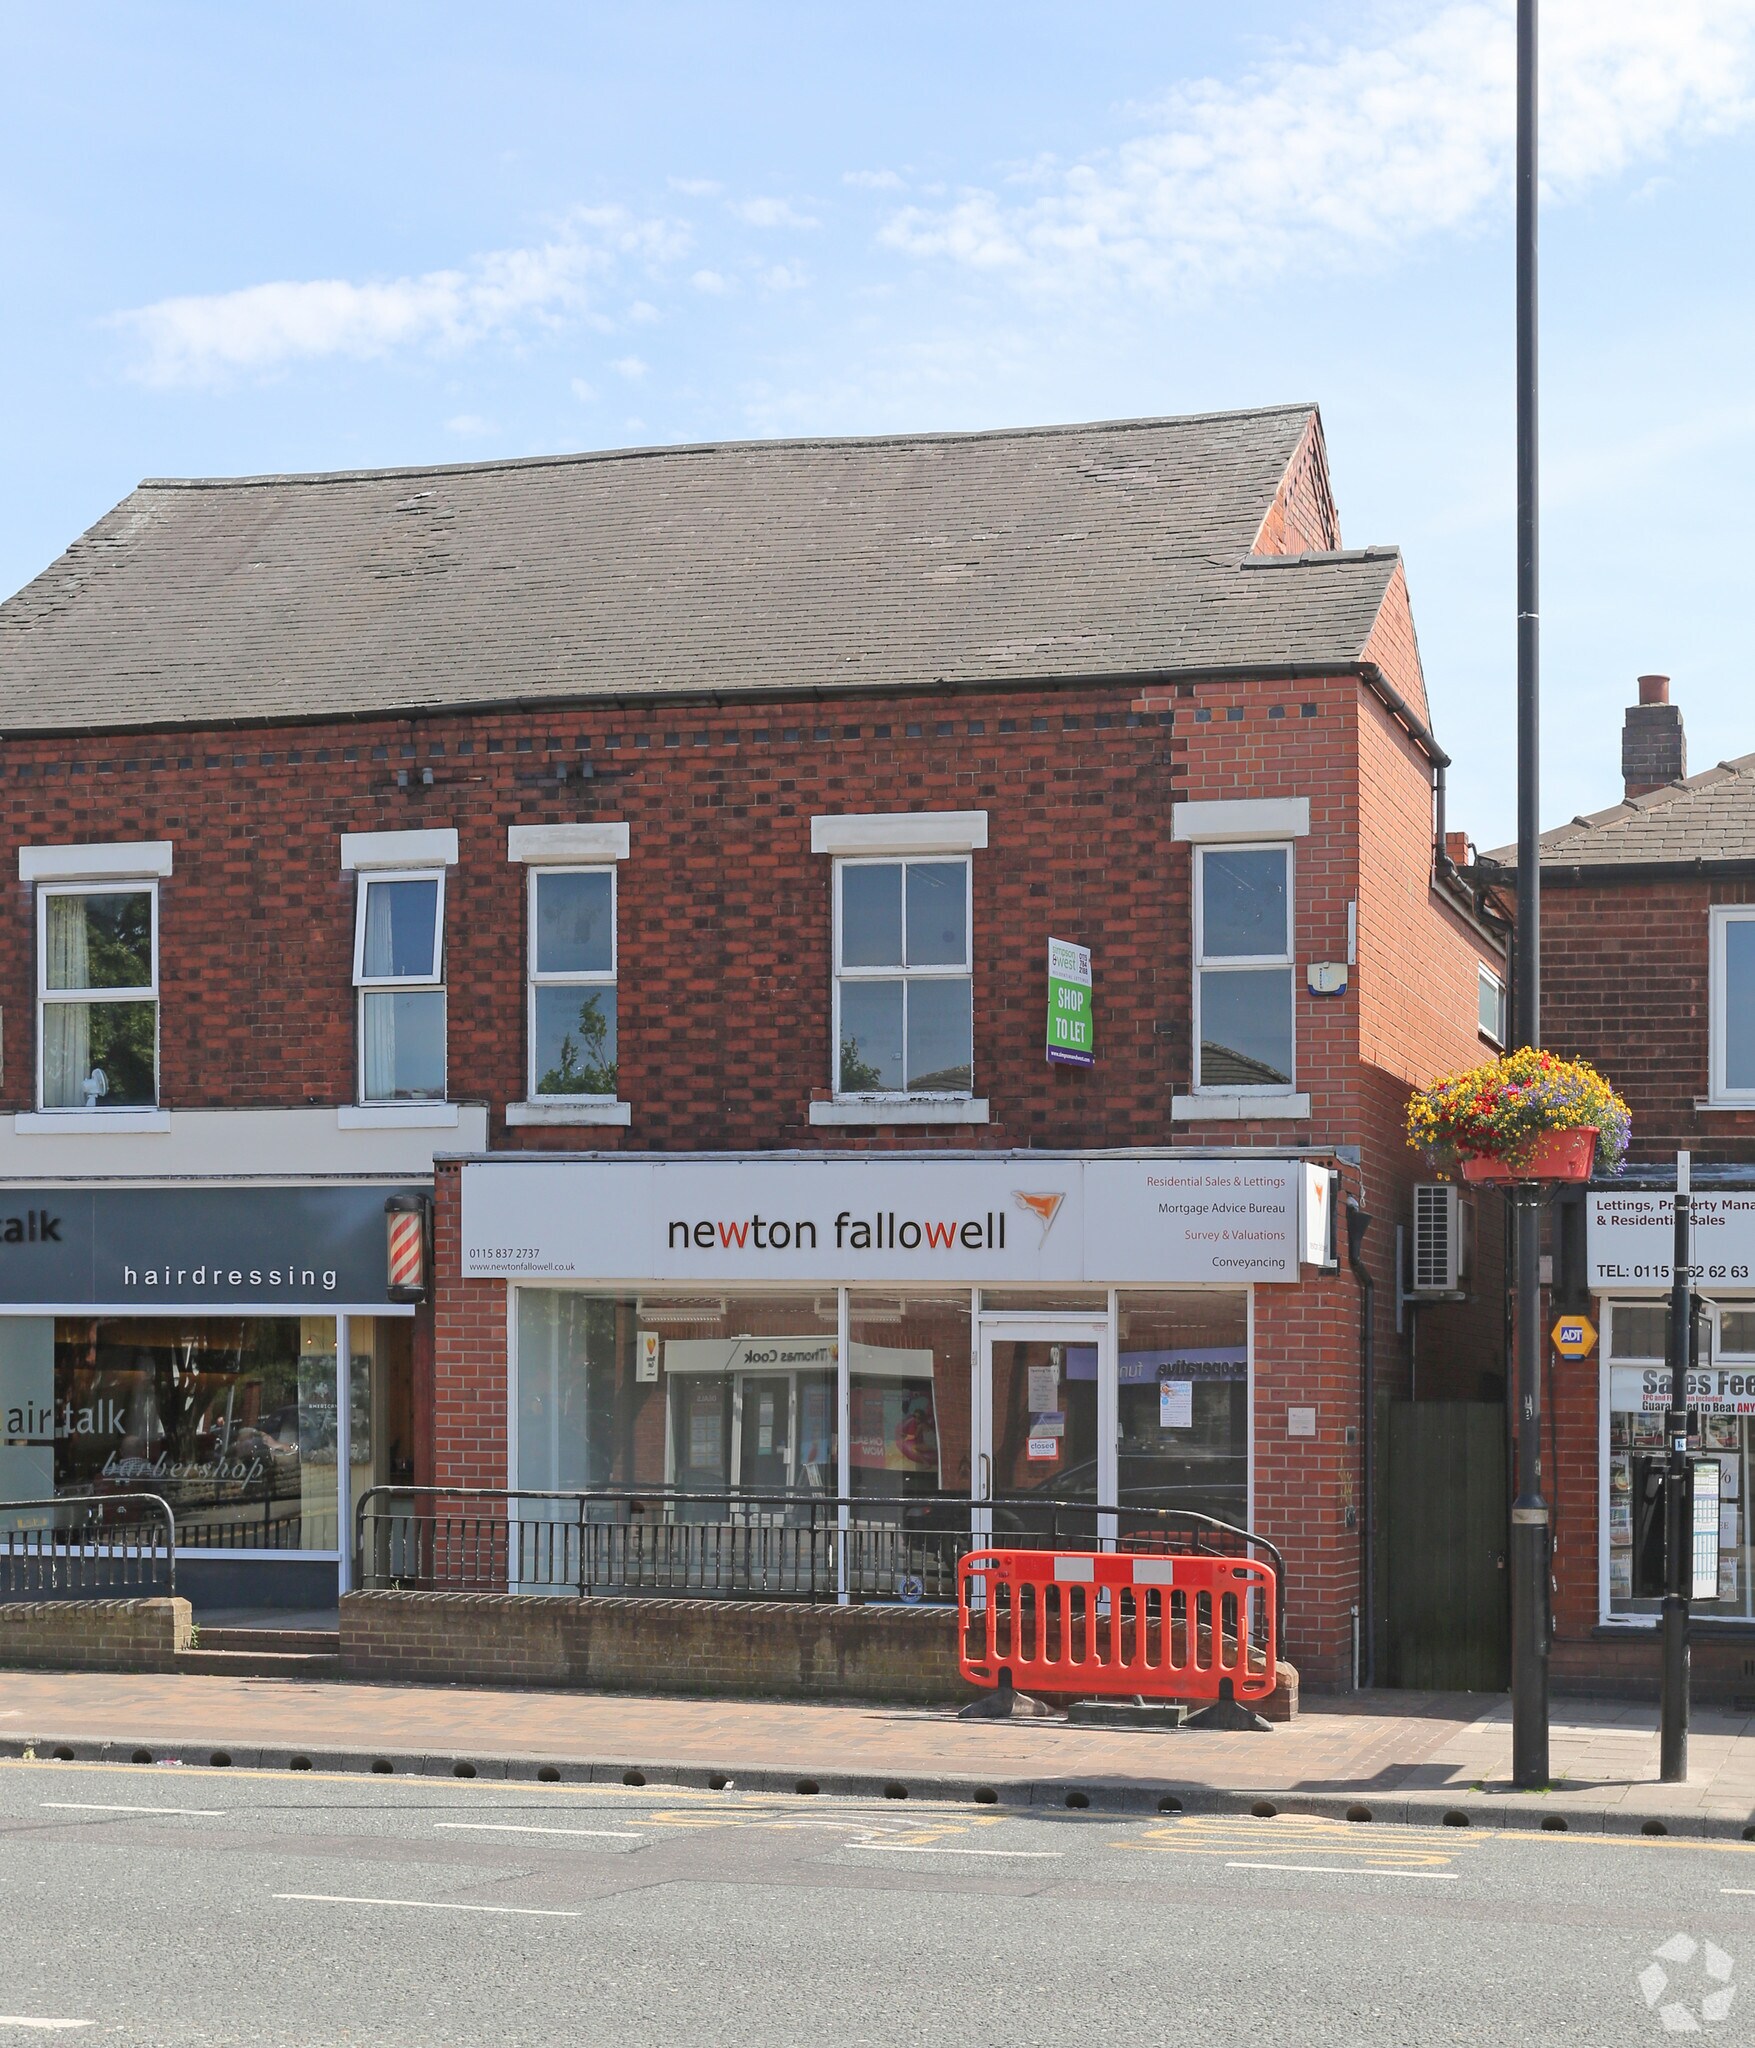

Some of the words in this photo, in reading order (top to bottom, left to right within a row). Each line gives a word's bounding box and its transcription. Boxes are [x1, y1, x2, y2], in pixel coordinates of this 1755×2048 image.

[1058, 987, 1083, 1012] SHOP
[1056, 1017, 1068, 1040] TO
[1070, 1020, 1085, 1043] LET
[1147, 1176, 1203, 1187] Residential
[1205, 1176, 1231, 1187] Sales
[1233, 1176, 1241, 1187] &
[1244, 1176, 1286, 1189] Lettings
[1158, 1203, 1209, 1216] Mortgage
[1211, 1203, 1247, 1213] Advice
[1249, 1203, 1286, 1213] Bureau
[1596, 1200, 1654, 1212] Lettings,
[1659, 1200, 1716, 1212] Prerty
[0, 1210, 62, 1242] alk
[1596, 1215, 1607, 1226] &
[1611, 1215, 1676, 1226] Residenti
[1690, 1214, 1726, 1226] Sales
[668, 1214, 817, 1249] newton
[834, 1211, 1006, 1249] fallowell
[1184, 1230, 1220, 1242] Survey
[1222, 1230, 1230, 1240] &
[1231, 1230, 1286, 1241] Valuations
[469, 1248, 493, 1258] 0115
[495, 1248, 514, 1258] 837
[516, 1248, 540, 1258] 2737
[469, 1262, 576, 1271] www.newtonfallowell.co.uk
[1212, 1256, 1286, 1269] Conveyancing
[124, 1266, 337, 1290] hairdressing
[1597, 1265, 1629, 1278] TEL:
[1634, 1265, 1670, 1278] 0115
[1708, 1265, 1727, 1278] 62
[1731, 1265, 1749, 1278] 63
[1561, 1329, 1583, 1341] ADT
[1642, 1369, 1712, 1396] Saes
[1642, 1401, 1699, 1412] Guaraed
[1701, 1402, 1711, 1412] to
[1713, 1402, 1736, 1413] Beat
[63, 1398, 127, 1434] talk
[1030, 1442, 1055, 1450] closed
[101, 1450, 265, 1490] barbershop
